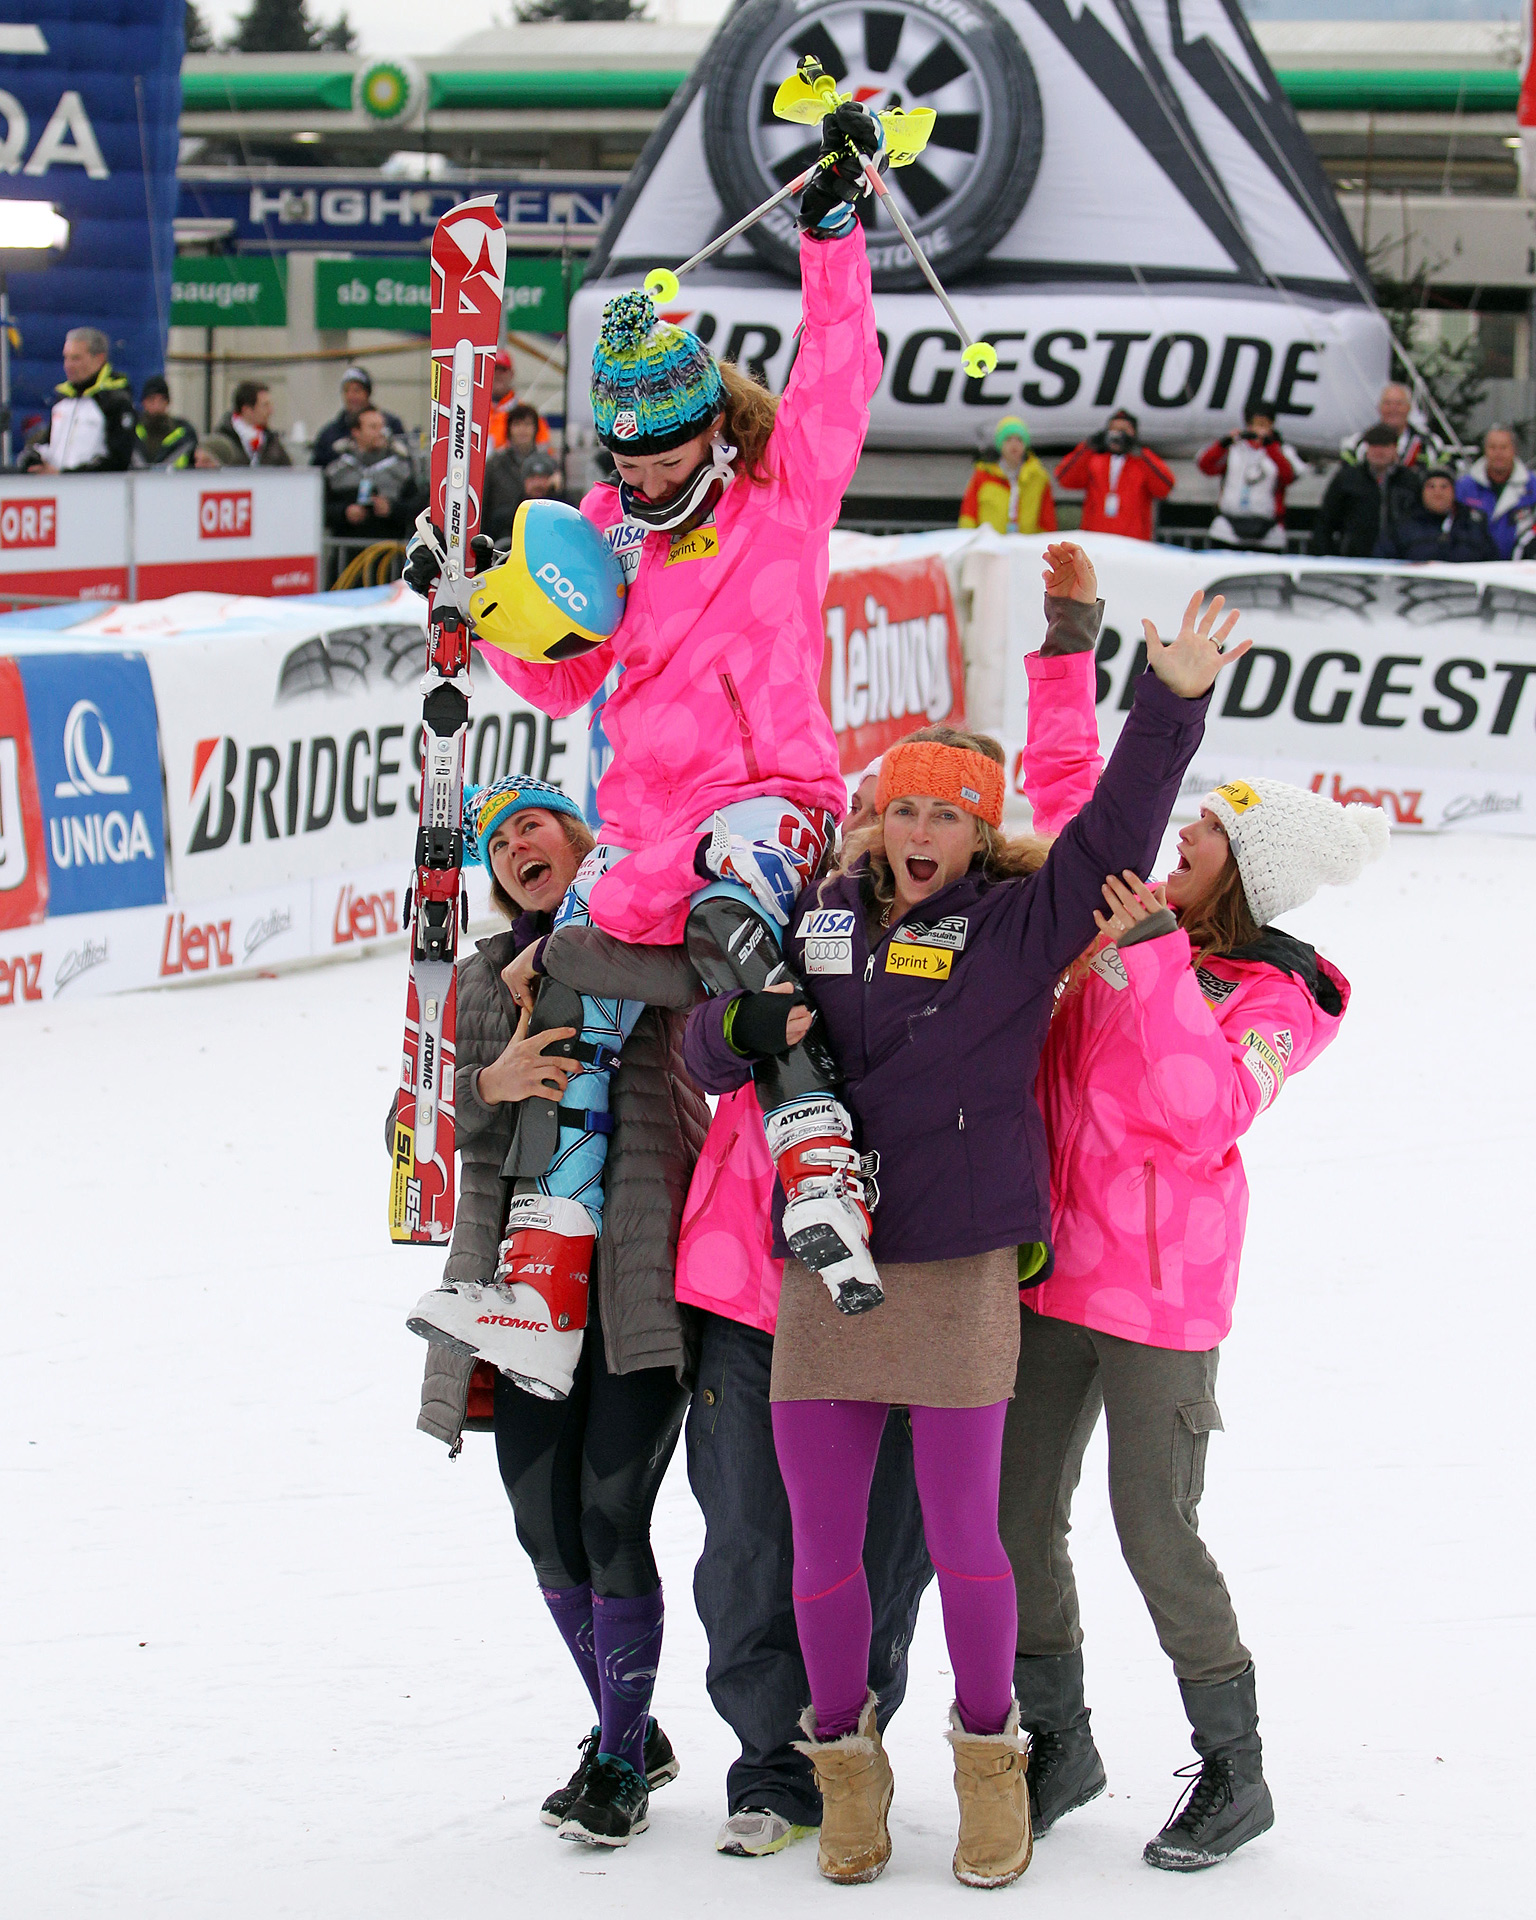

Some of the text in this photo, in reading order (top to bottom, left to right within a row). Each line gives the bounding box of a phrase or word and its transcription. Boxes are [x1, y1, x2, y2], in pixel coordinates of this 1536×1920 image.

[655, 312, 1327, 416] RGESTONE
[453, 404, 466, 460] ATOMIC
[2, 508, 54, 542] ORF
[201, 498, 250, 531] ORF
[607, 525, 646, 548] VISA
[1096, 626, 1536, 735] BDGEST
[186, 711, 568, 855] BRIDGEONE
[50, 810, 155, 869] UNIQA
[333, 882, 398, 946] Lienz
[806, 913, 856, 934] VISA
[160, 911, 233, 977] Lienz
[903, 930, 918, 942] 3M
[809, 964, 825, 972] Audi
[889, 952, 929, 970] Sprint
[1090, 960, 1107, 975] Audi
[422, 1031, 435, 1090] ATOMIC
[1245, 1032, 1278, 1068] NATURE
[780, 1104, 835, 1127] ATOMIC
[396, 1130, 411, 1170] SL
[406, 1177, 422, 1231] 165
[475, 1314, 549, 1333] ATOMIC
